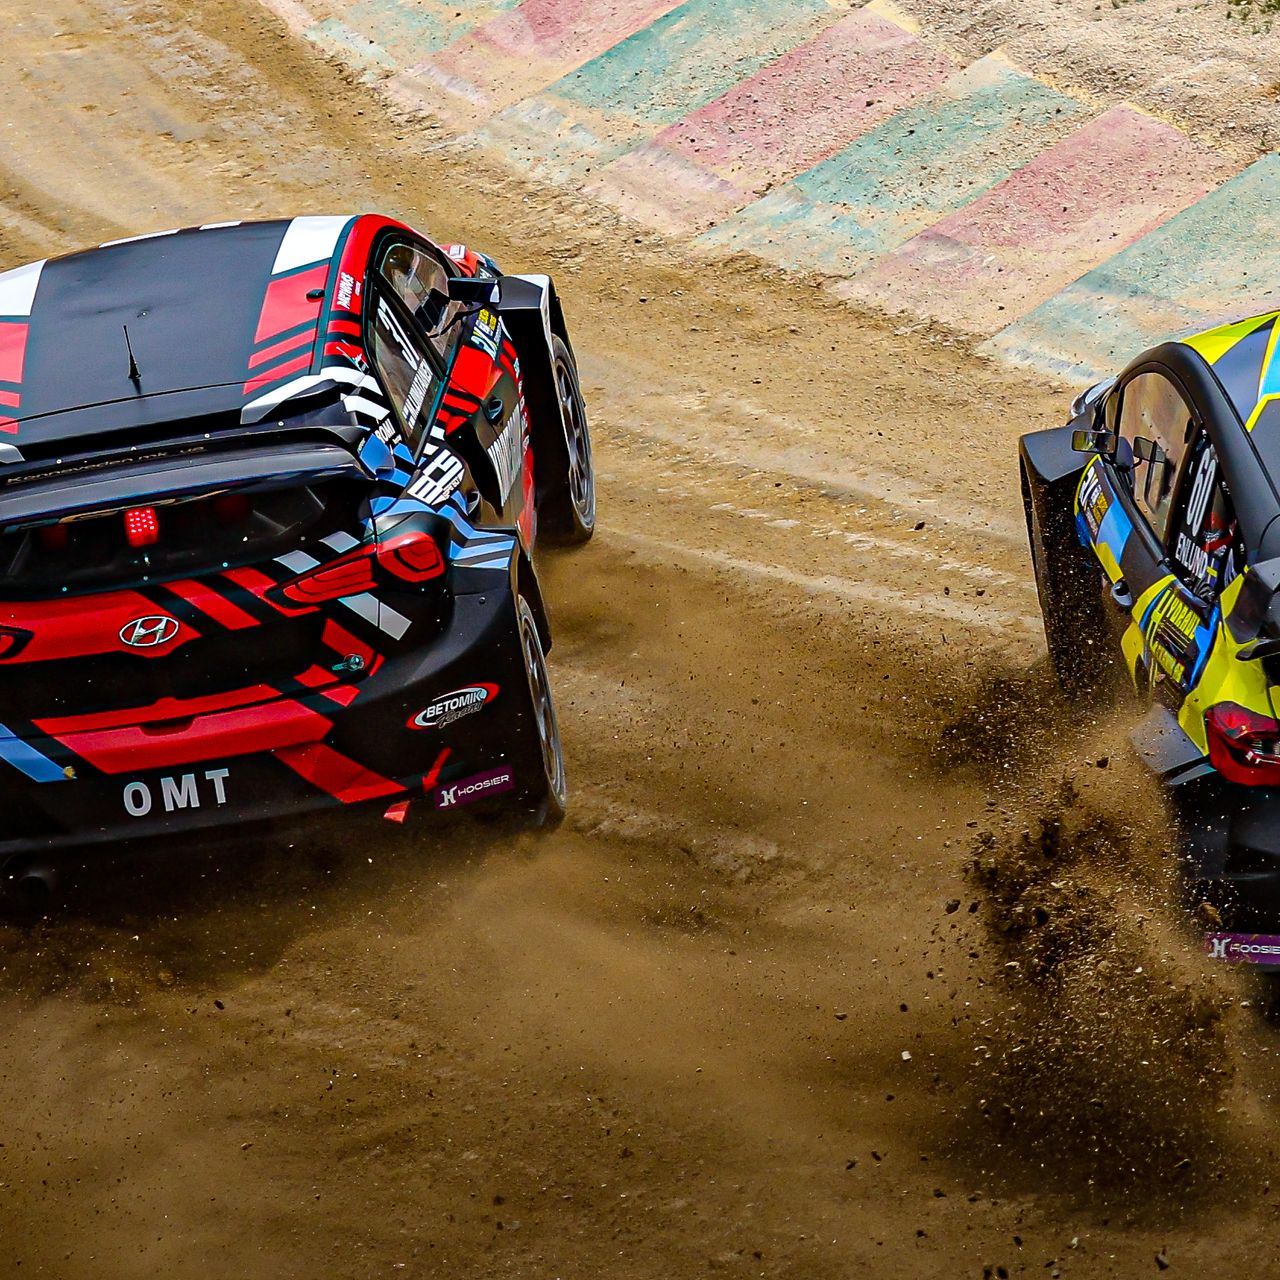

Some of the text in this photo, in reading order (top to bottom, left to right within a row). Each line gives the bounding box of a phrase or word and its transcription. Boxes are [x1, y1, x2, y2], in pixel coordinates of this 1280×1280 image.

[377, 295, 420, 371] 37
[1186, 447, 1217, 537] 60
[1175, 531, 1209, 579] ENLUND
[426, 689, 483, 718] BETOMIK
[435, 700, 485, 728] Racing
[123, 768, 230, 817] OMT
[457, 774, 510, 797] HOOSIER
